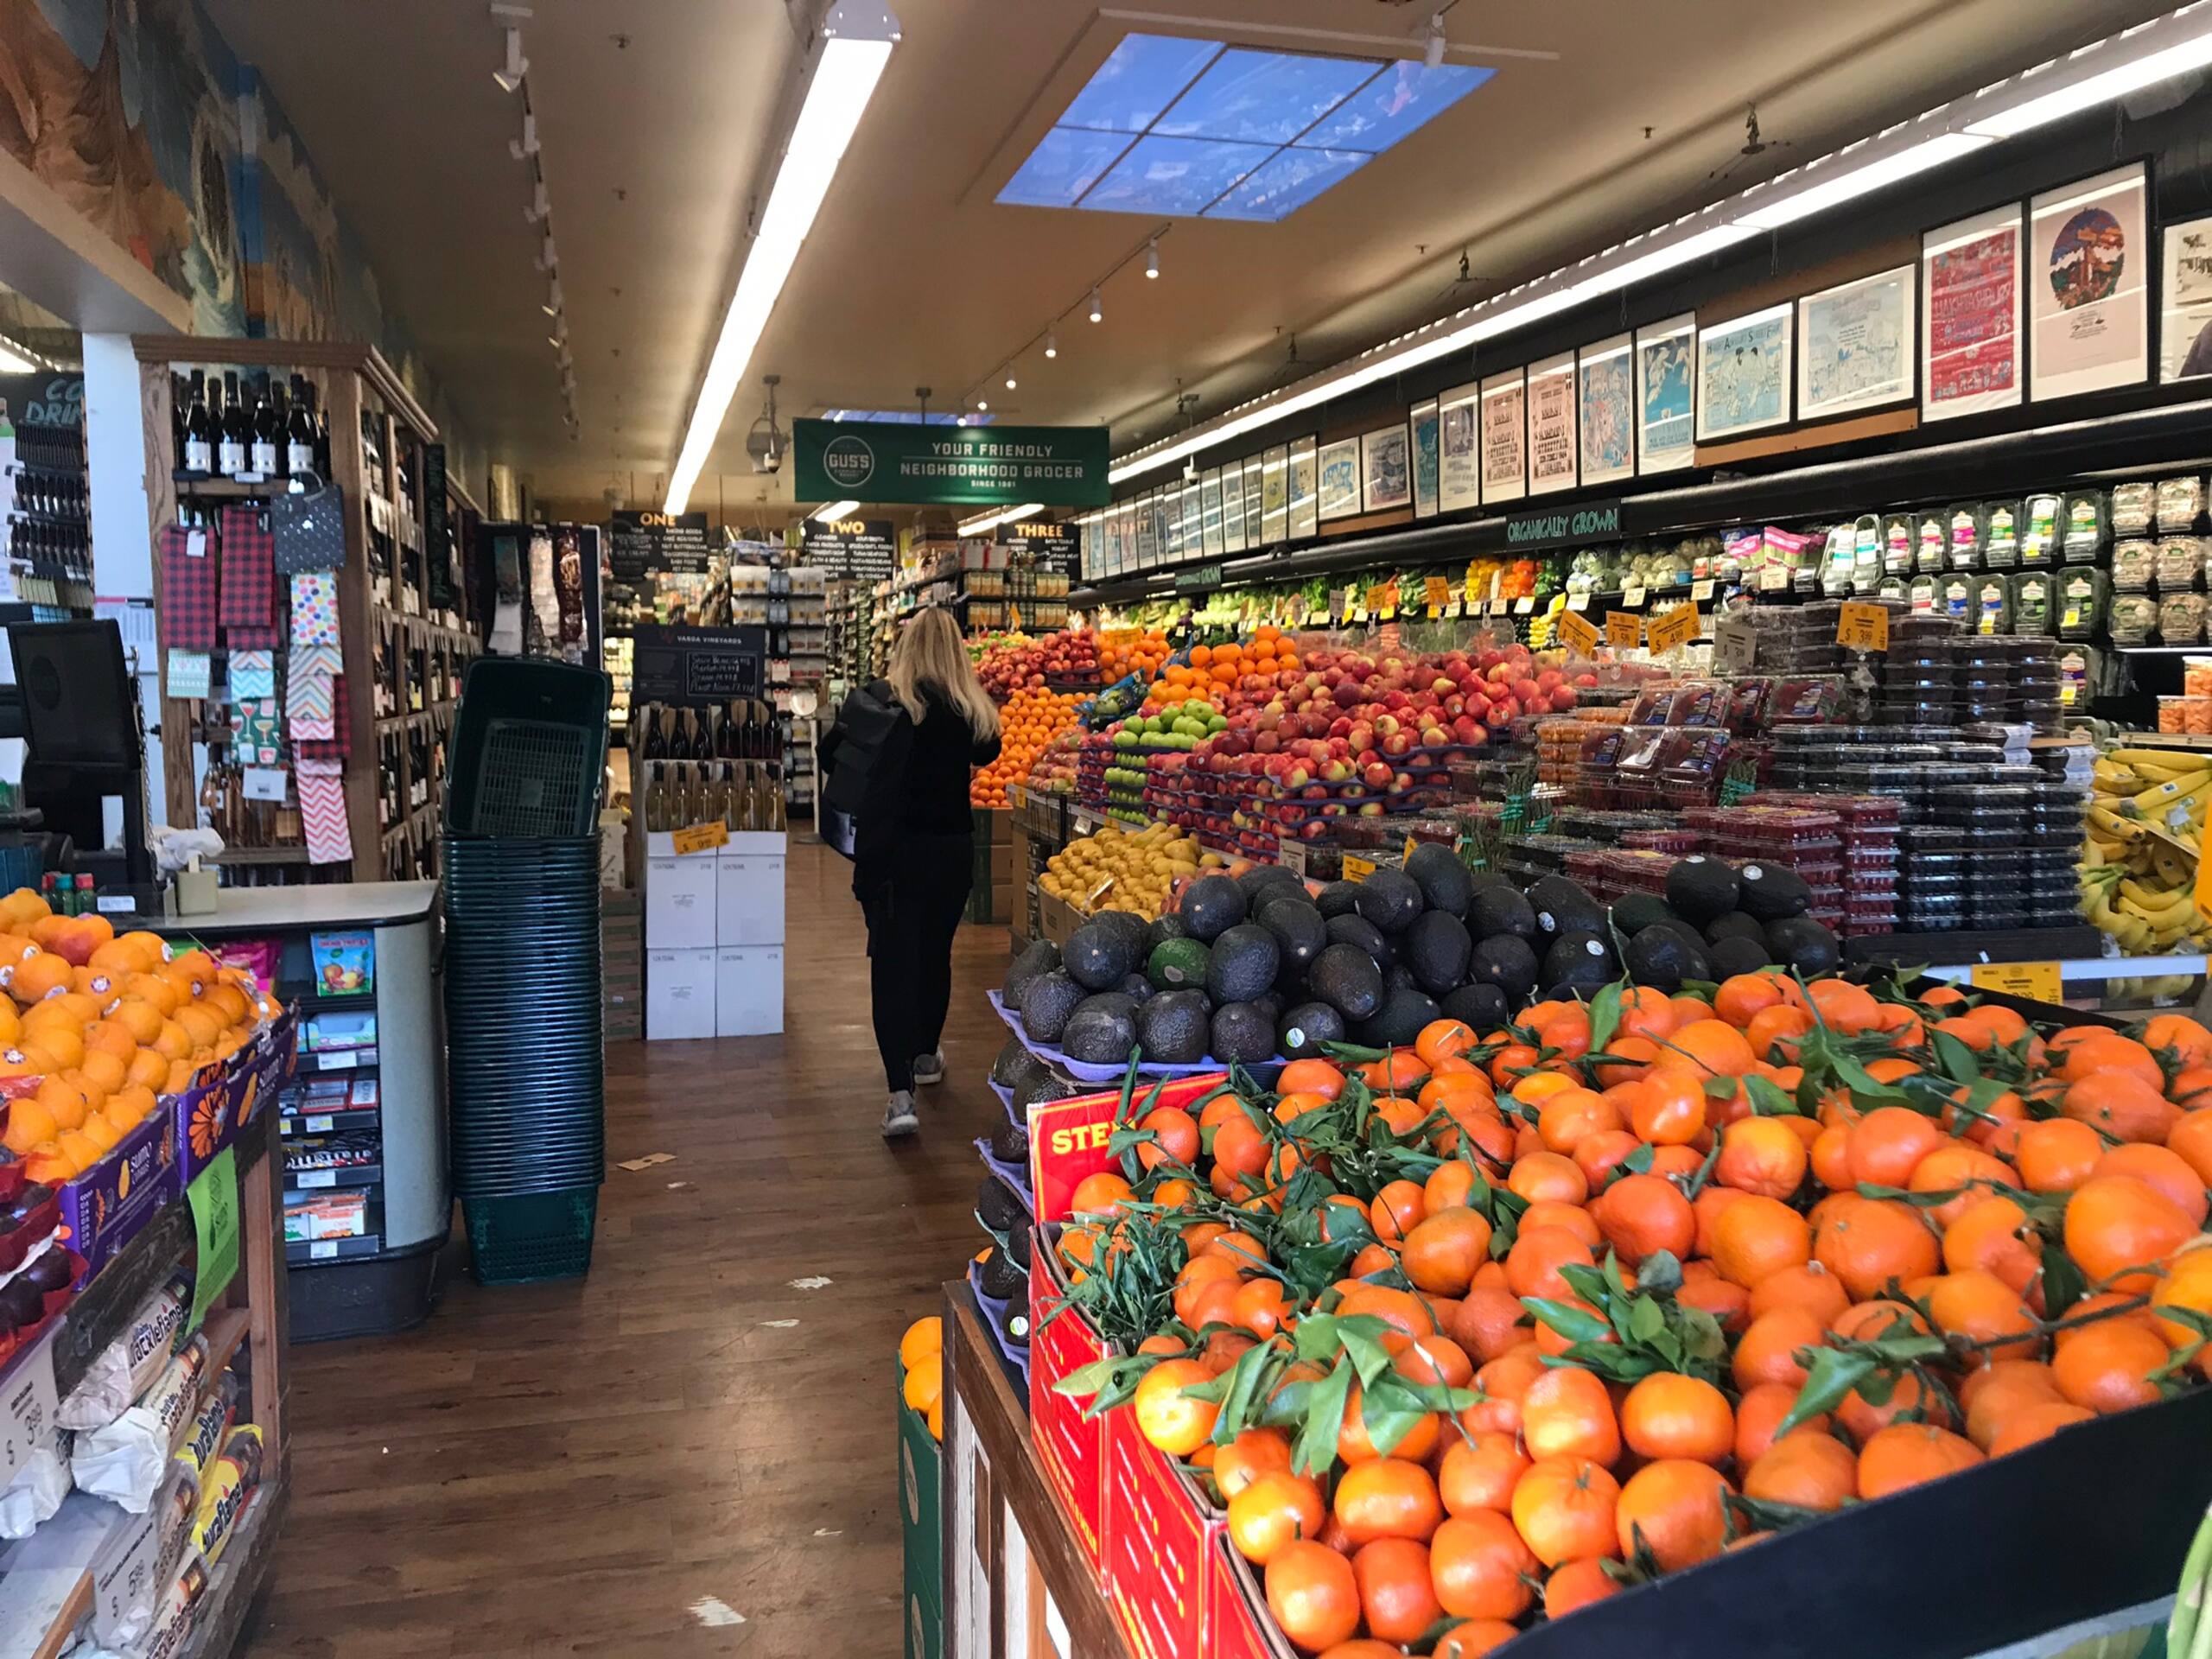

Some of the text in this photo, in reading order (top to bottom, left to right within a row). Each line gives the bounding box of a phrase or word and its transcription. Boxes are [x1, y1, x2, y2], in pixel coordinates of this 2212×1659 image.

[932, 442, 1052, 457] YOUR FRIENDLY
[900, 462, 1084, 479] NEIGHBORHOOD GROCER
[639, 512, 676, 526] ONE
[1507, 508, 1618, 542] ORGANICALLY GROWN
[828, 521, 865, 534] TWO
[1014, 524, 1064, 537] THREE
[702, 636, 742, 645] VINEYARDS
[1845, 627, 1852, 641] $
[130, 1304, 183, 1369] rackleflame
[6, 1439, 15, 1466] $
[111, 1595, 118, 1618] $
